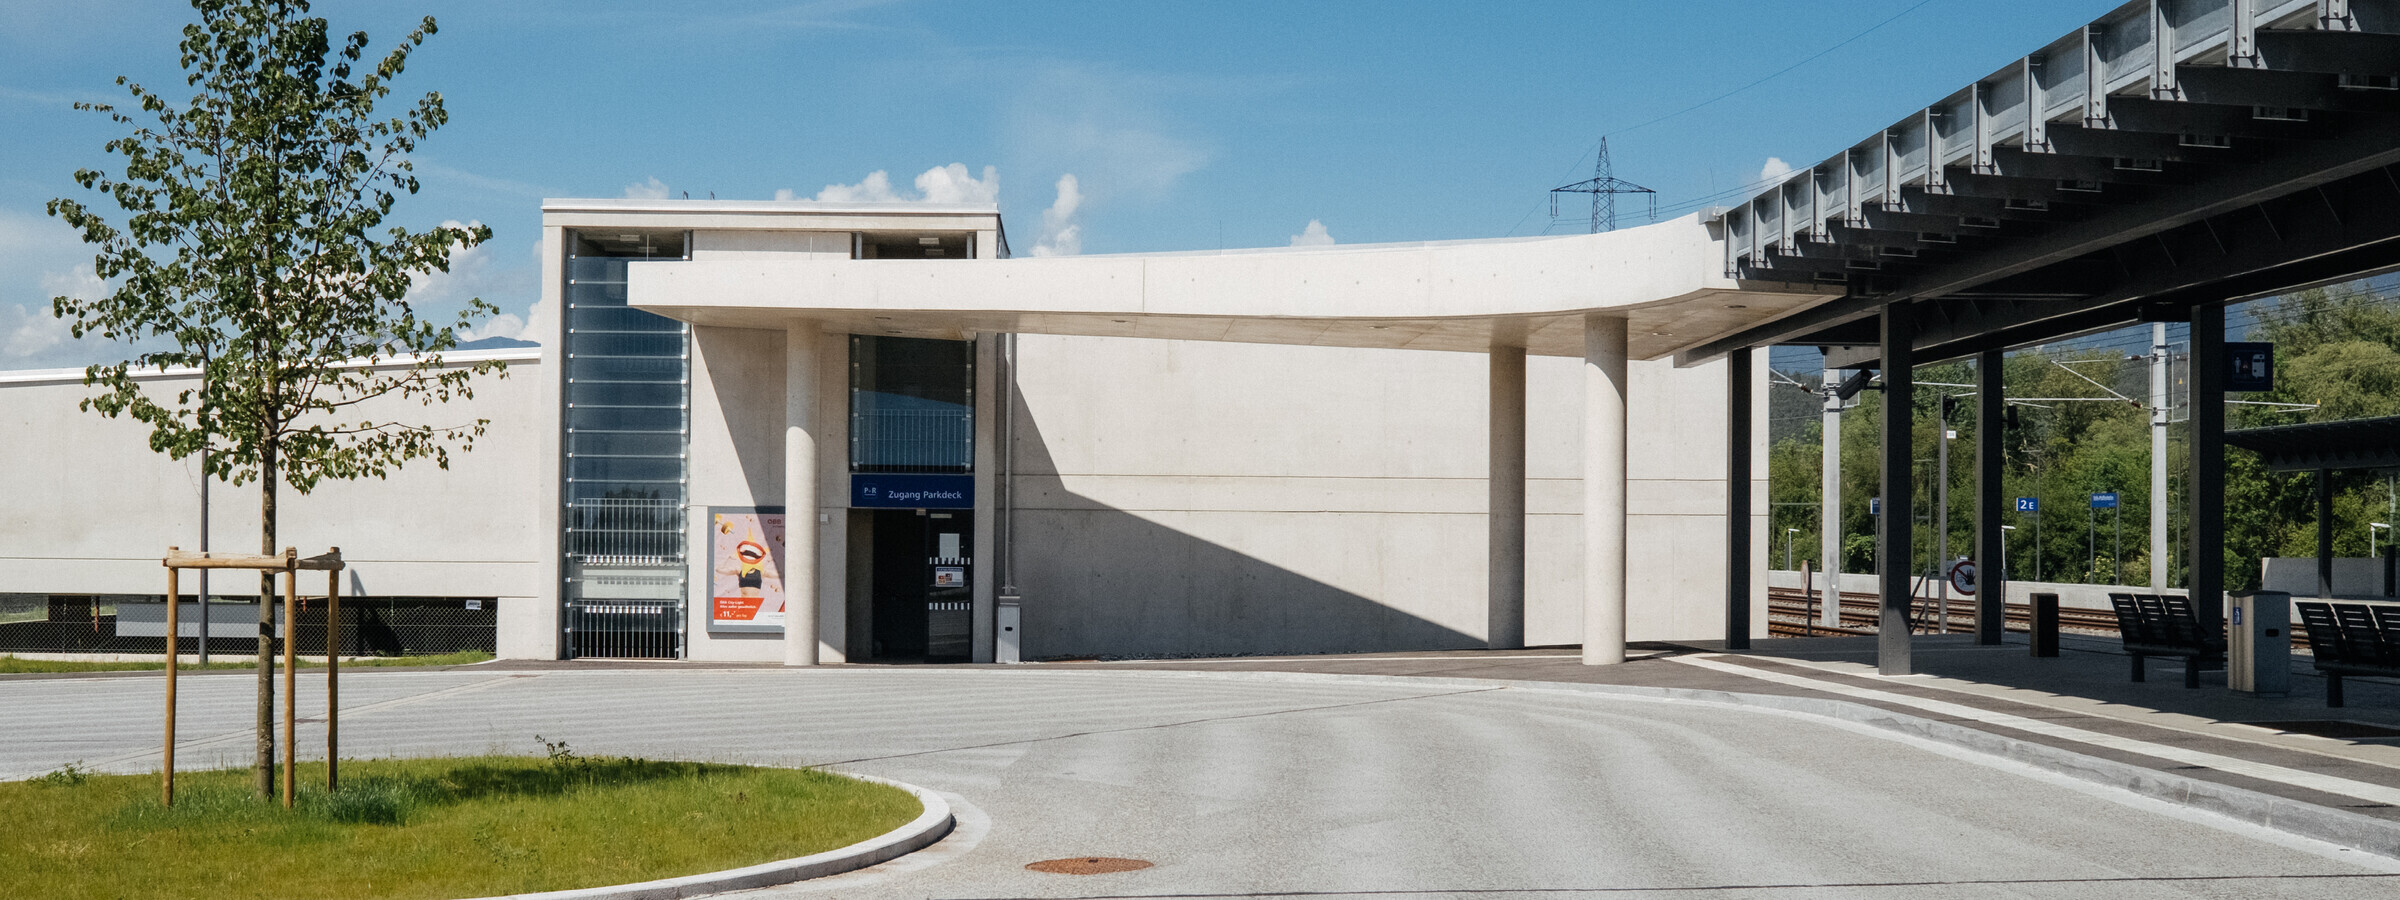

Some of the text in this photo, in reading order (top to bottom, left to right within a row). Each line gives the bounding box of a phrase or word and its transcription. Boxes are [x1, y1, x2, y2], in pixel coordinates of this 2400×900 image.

[888, 490, 962, 501] Zugang Parkdeck
[2020, 499, 2034, 509] 2 E
